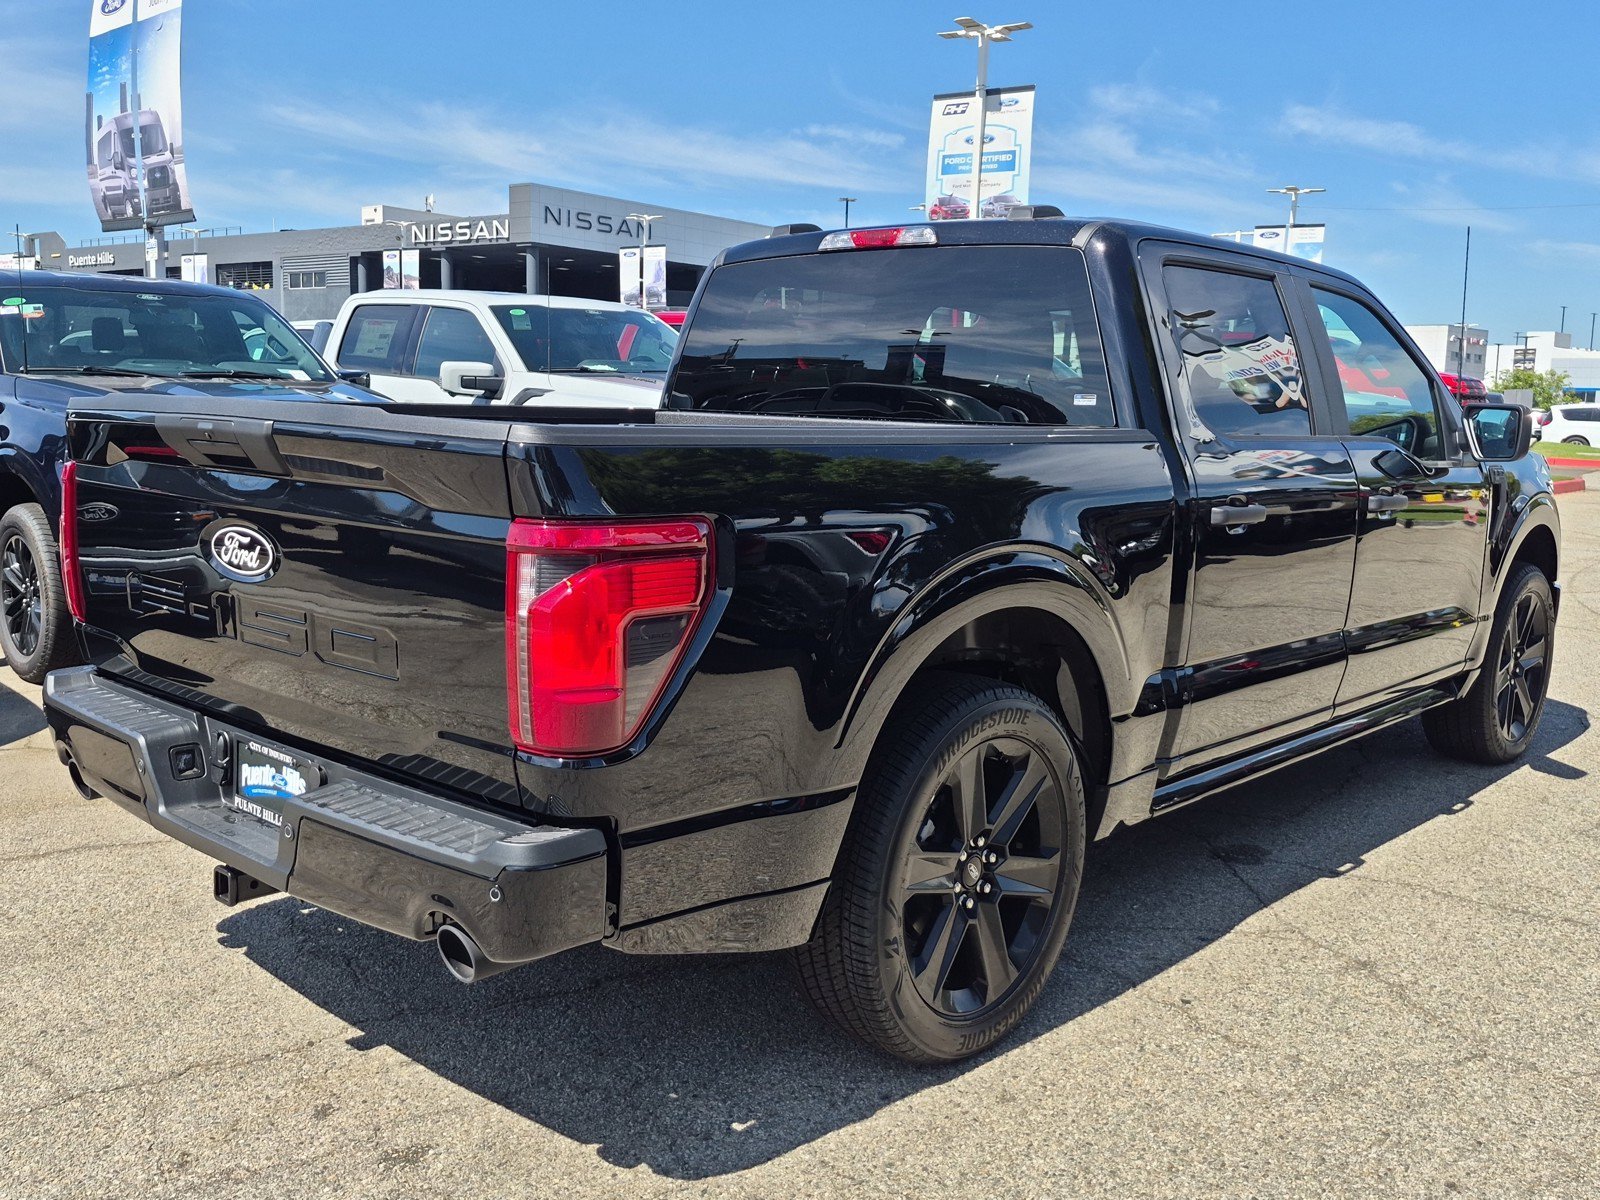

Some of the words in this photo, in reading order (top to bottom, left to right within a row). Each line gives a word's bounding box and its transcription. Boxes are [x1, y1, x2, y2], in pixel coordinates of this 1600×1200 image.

[945, 157, 965, 165] FORD
[967, 154, 1013, 163] CRTIFIED
[411, 218, 510, 243] NISSAN
[544, 205, 652, 241] NISSAN
[69, 254, 96, 267] Puente
[97, 251, 115, 266] Hills
[220, 531, 261, 569] Ford
[249, 741, 262, 753] CITY
[241, 763, 277, 787] Puente
[282, 765, 307, 796] Hills
[234, 796, 261, 818] PUENTE
